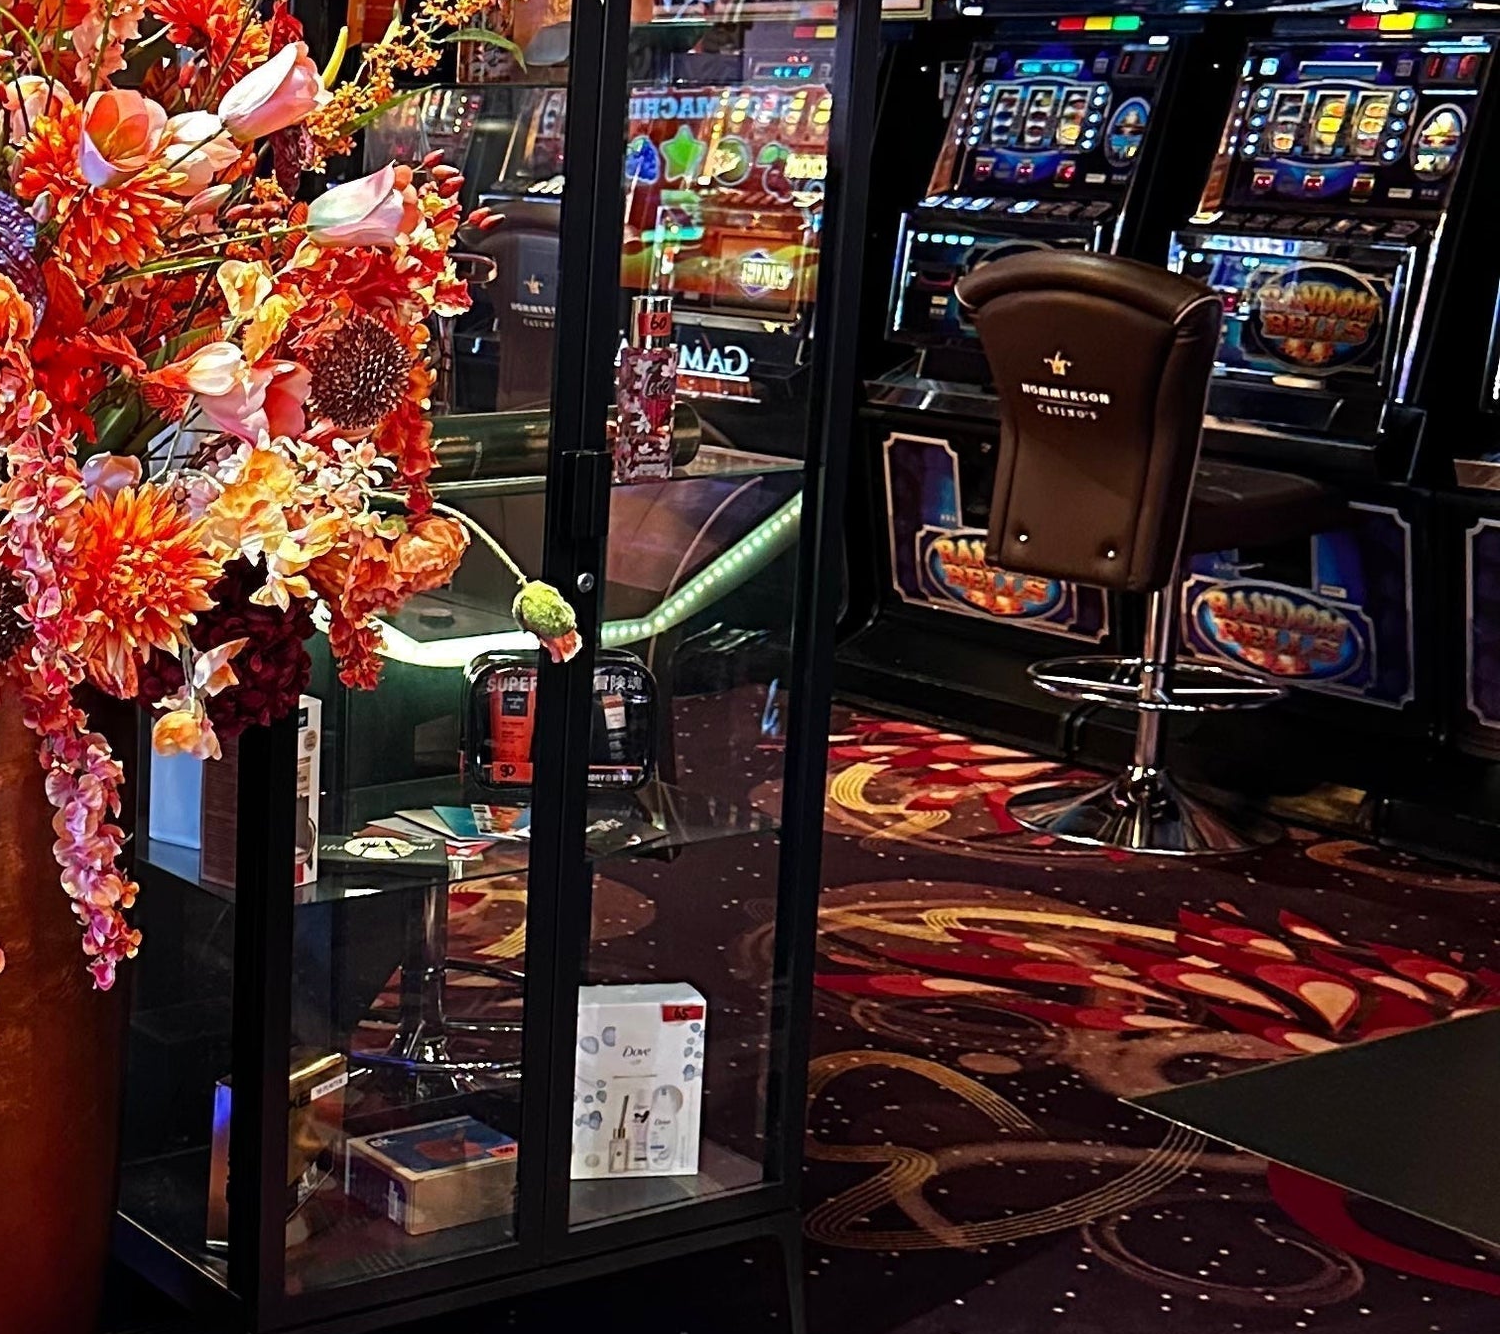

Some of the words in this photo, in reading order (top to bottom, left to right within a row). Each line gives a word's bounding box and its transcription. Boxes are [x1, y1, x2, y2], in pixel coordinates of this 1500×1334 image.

[1258, 283, 1379, 322] RANDOM
[650, 314, 667, 331] 60
[1262, 313, 1369, 346] BELLS
[1021, 382, 1110, 405] HOMMERSON
[941, 565, 1049, 603] BELLS
[1203, 590, 1350, 640] RANDOM
[1213, 617, 1341, 662] BELLS
[622, 1045, 651, 1058] Dove
